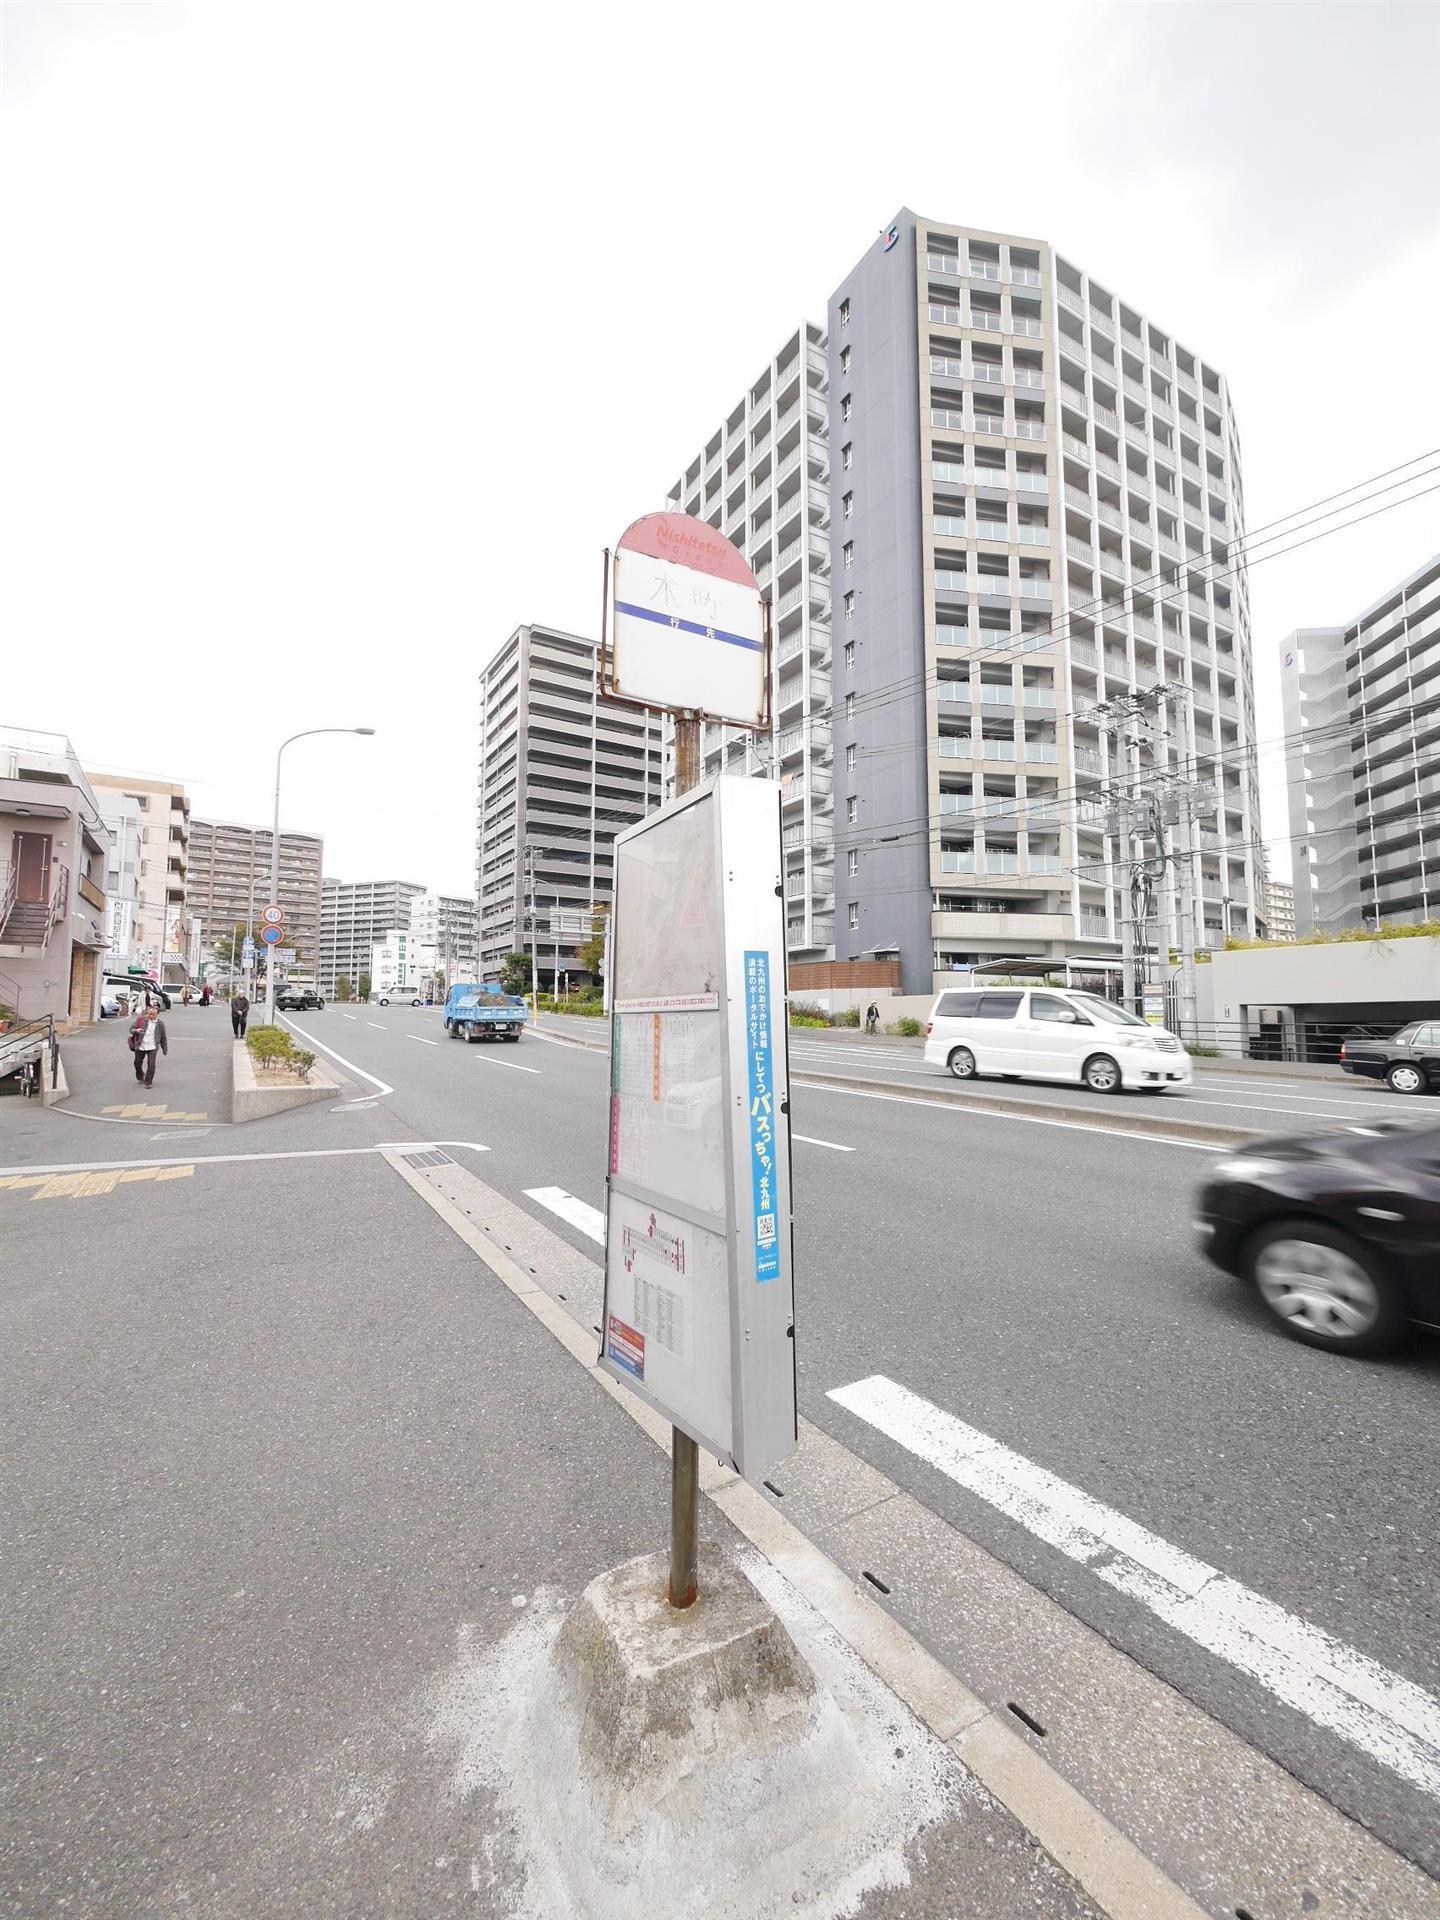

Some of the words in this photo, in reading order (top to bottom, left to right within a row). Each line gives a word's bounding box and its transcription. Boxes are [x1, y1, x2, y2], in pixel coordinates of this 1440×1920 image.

[656, 526, 727, 556] Nishitetsu
[670, 617, 716, 638] 行先
[267, 911, 279, 920] 40
[748, 958, 759, 1049] 満載のポータルサイト
[756, 958, 768, 1049] 北九州のおでかけ情報
